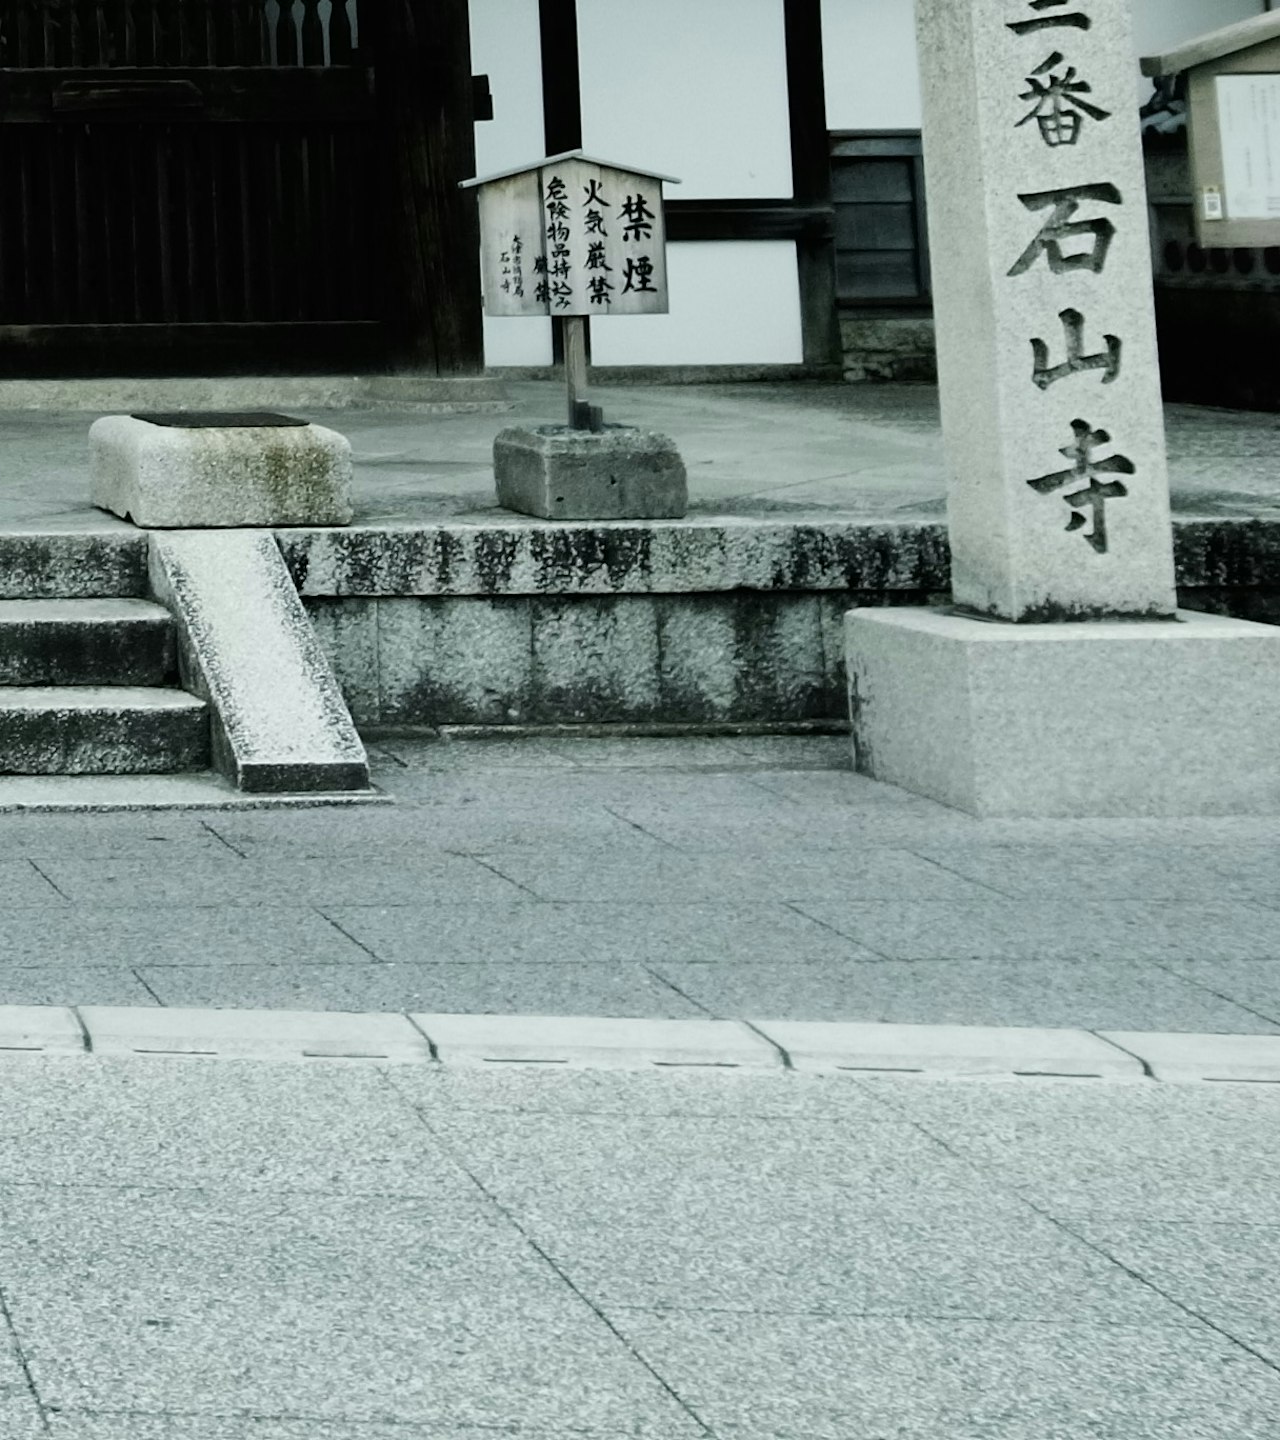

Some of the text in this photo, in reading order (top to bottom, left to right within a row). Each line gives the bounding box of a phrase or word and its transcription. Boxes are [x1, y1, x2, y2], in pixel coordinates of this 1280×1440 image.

[546, 176, 572, 309] 危険物品持込み
[583, 179, 615, 305] 火気厳禁
[616, 193, 658, 295] 禁煙
